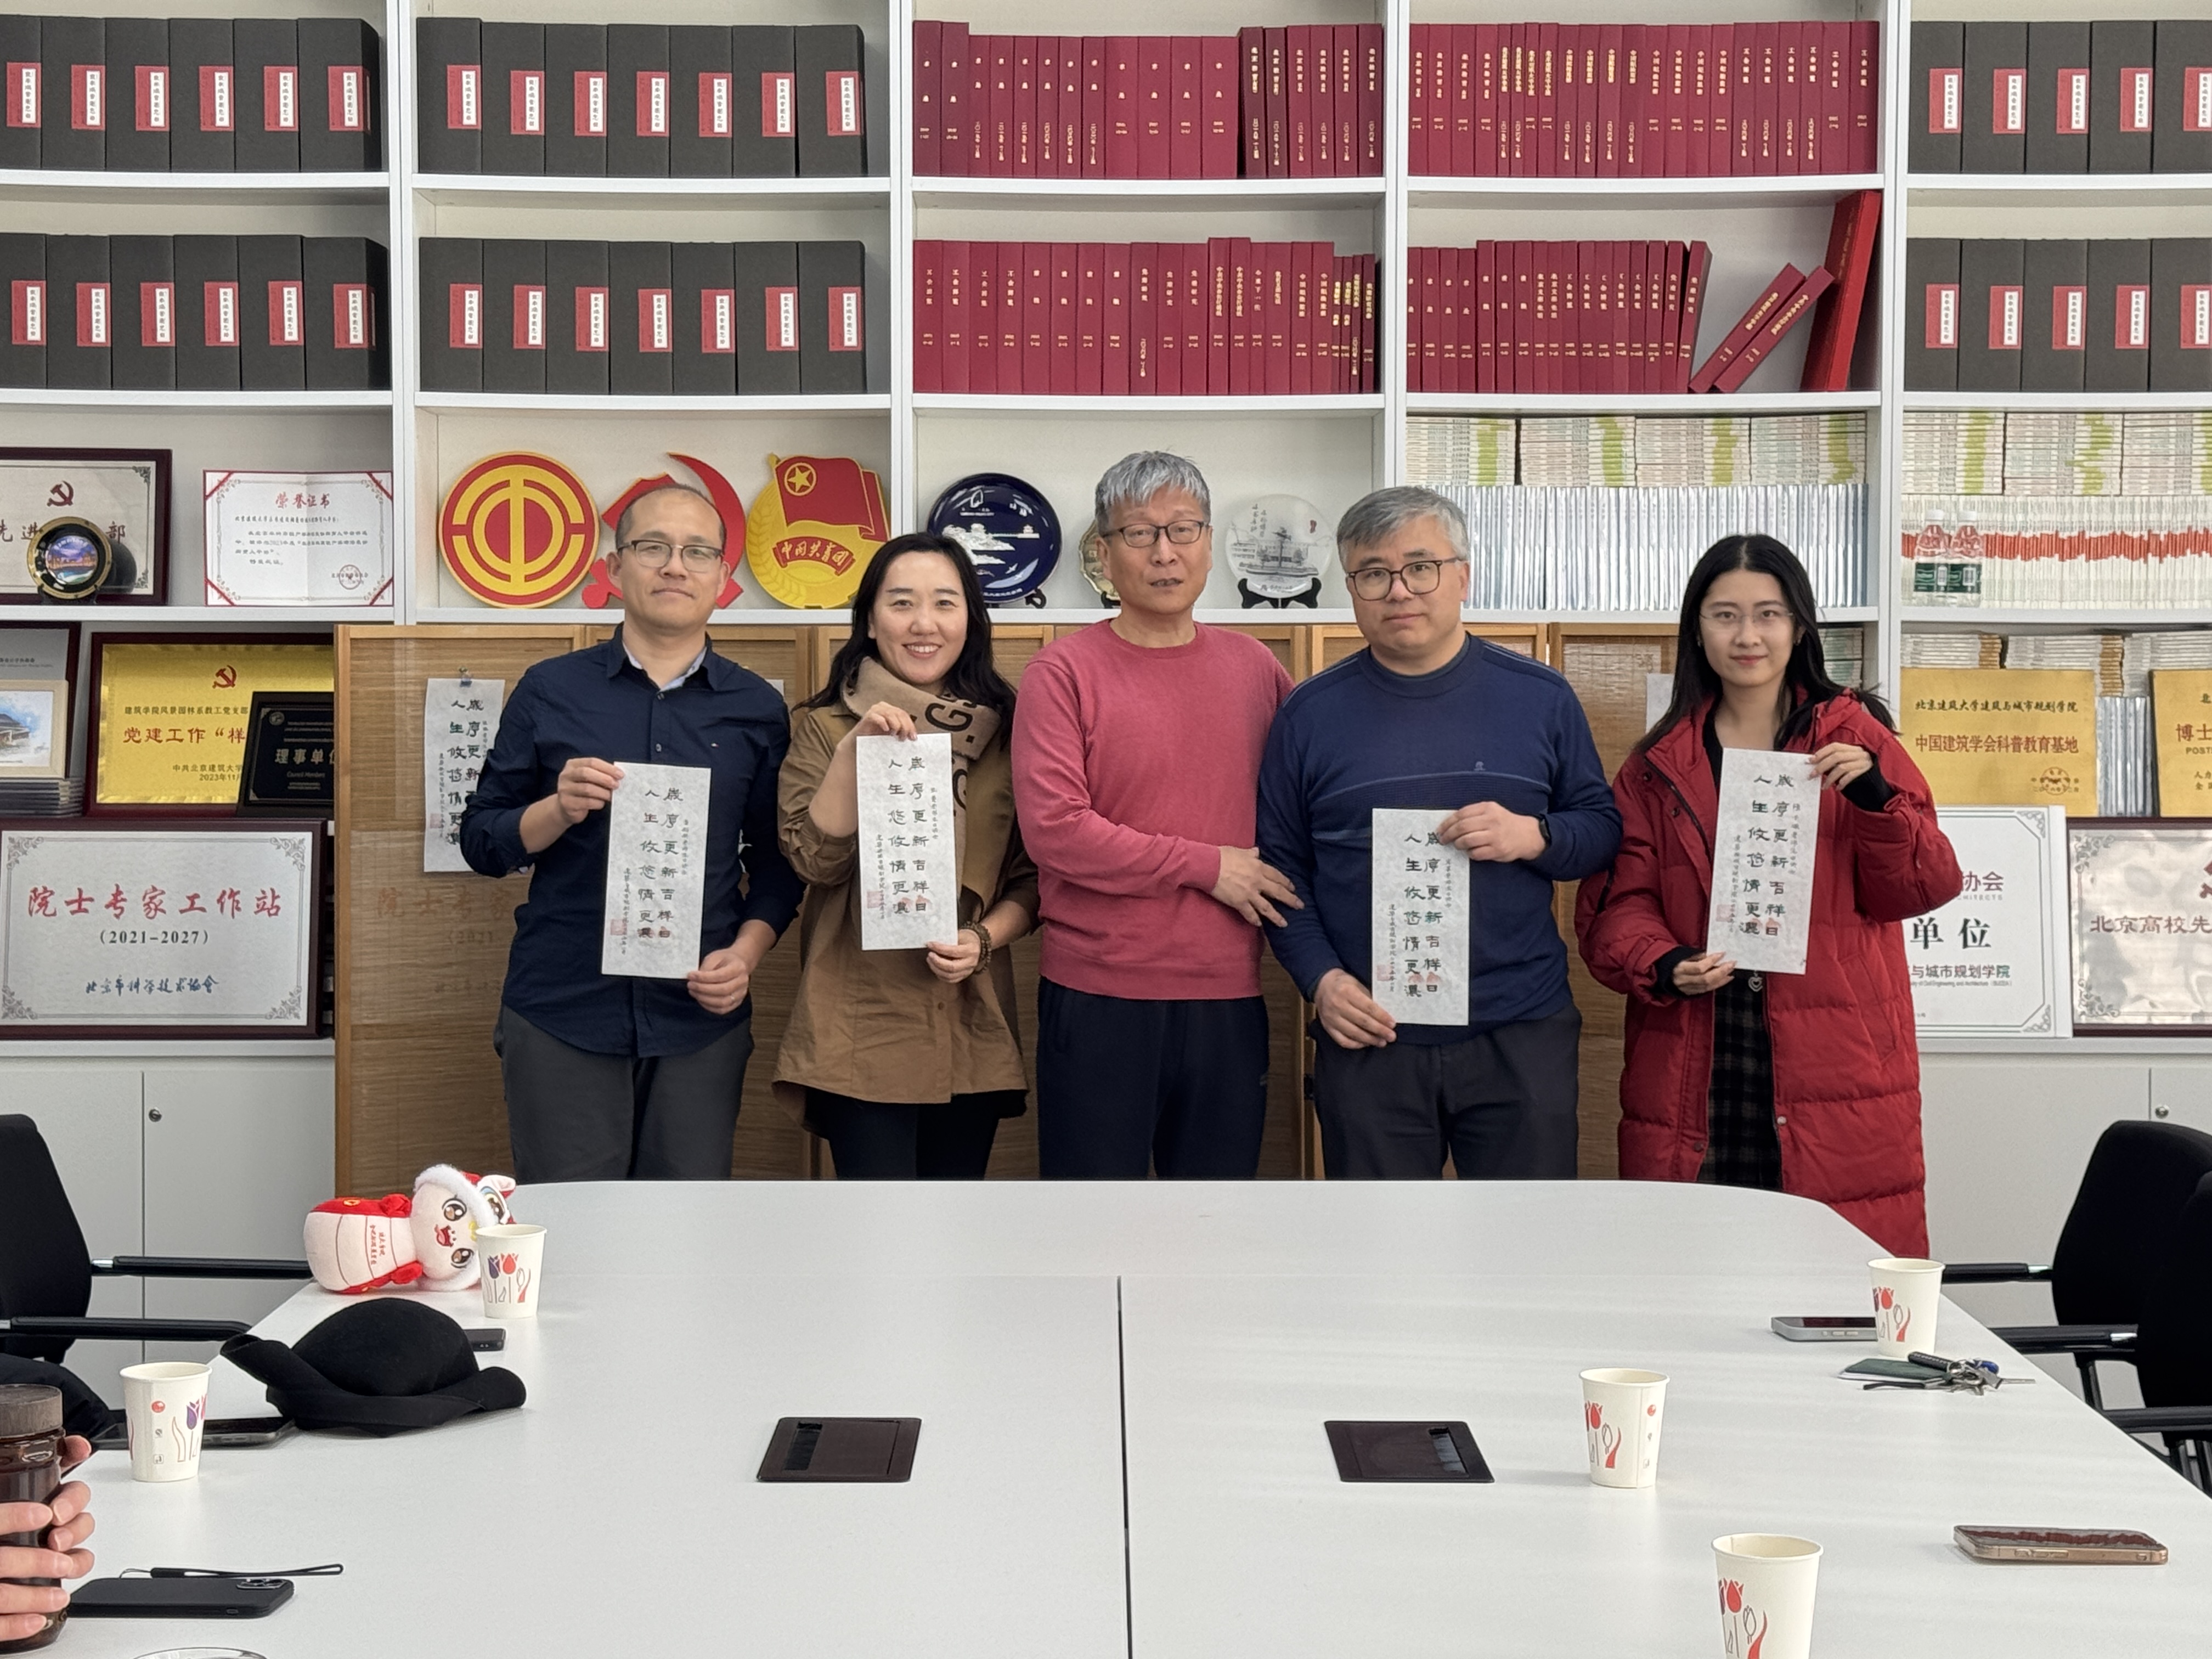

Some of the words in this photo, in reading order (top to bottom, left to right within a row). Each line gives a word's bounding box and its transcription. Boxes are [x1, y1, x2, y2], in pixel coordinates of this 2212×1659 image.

[1915, 734, 2079, 754] 中国建筑学会科普教育基地
[28, 884, 282, 919] 院士专家工作站
[1910, 917, 1991, 950] 单位
[2090, 915, 2212, 934] 北京高校先
[1909, 964, 2011, 978] 与城市规划学院
